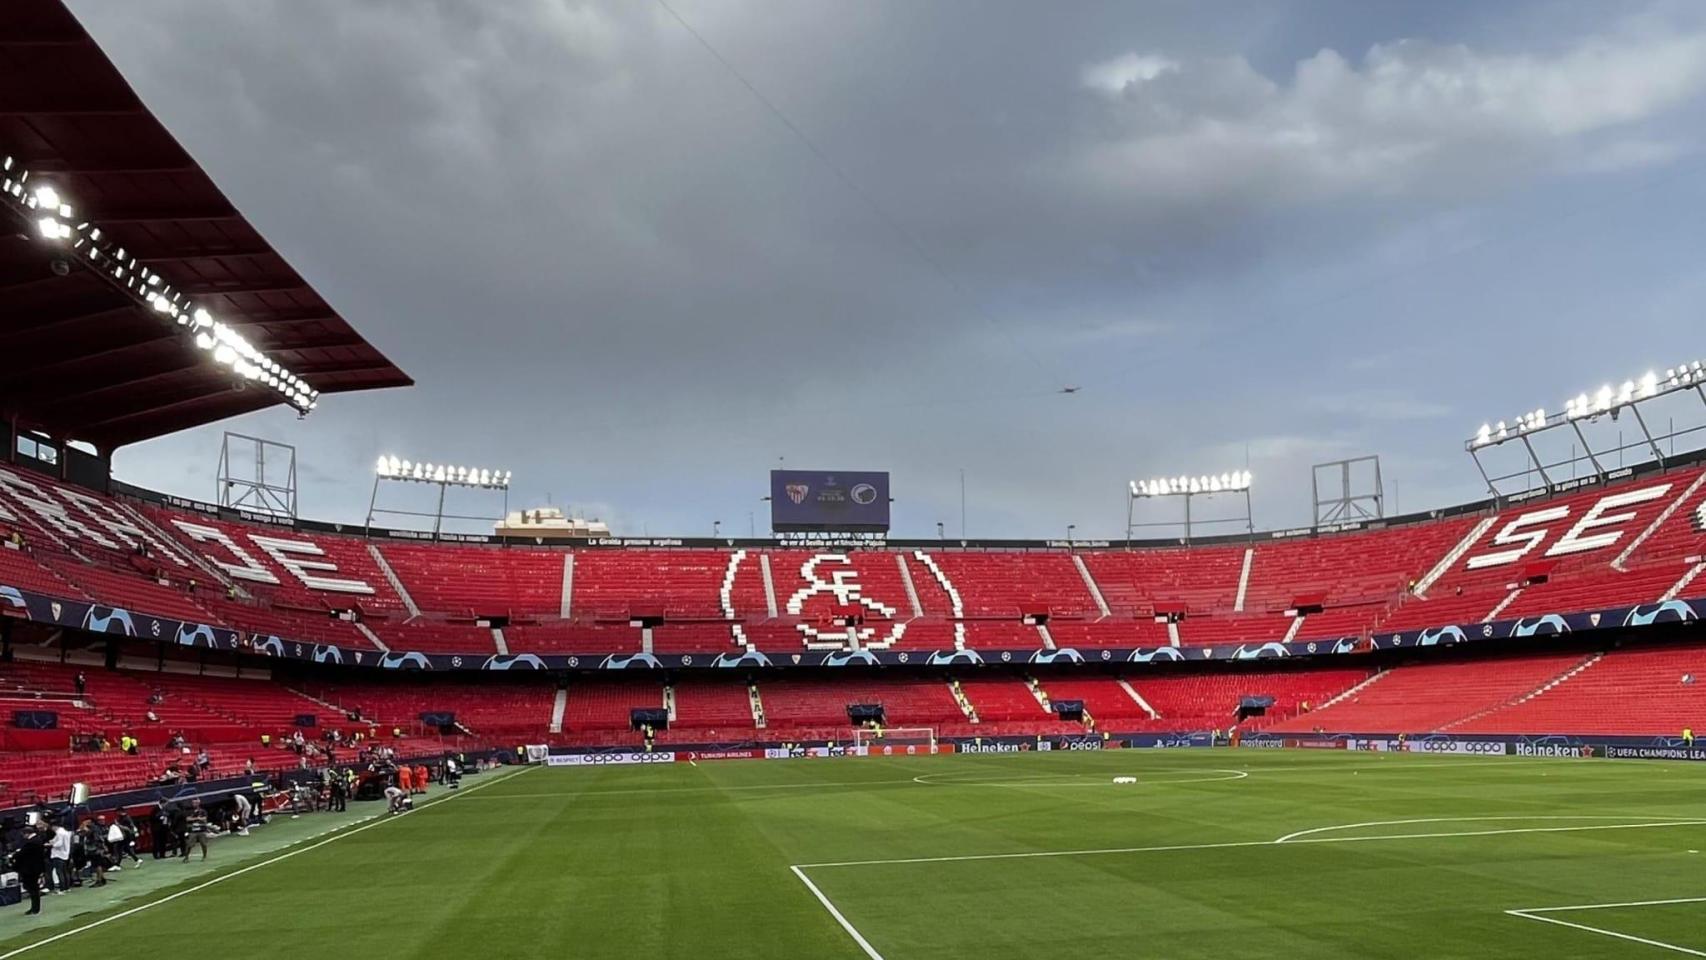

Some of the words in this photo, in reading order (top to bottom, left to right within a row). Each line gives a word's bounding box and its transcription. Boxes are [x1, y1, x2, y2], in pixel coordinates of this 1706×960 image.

[1466, 483, 1706, 569] SE
[961, 743, 1018, 753] Heineken
[1166, 739, 1191, 747] PS5
[1240, 739, 1282, 748] mastercard
[1424, 741, 1457, 753] oppo
[1465, 742, 1500, 755] oppo
[1516, 743, 1579, 758] Heineken
[1617, 748, 1637, 757] UEFA
[1639, 749, 1687, 758] CHAMPIONS
[584, 753, 623, 765] oppo
[632, 752, 670, 764] oppo
